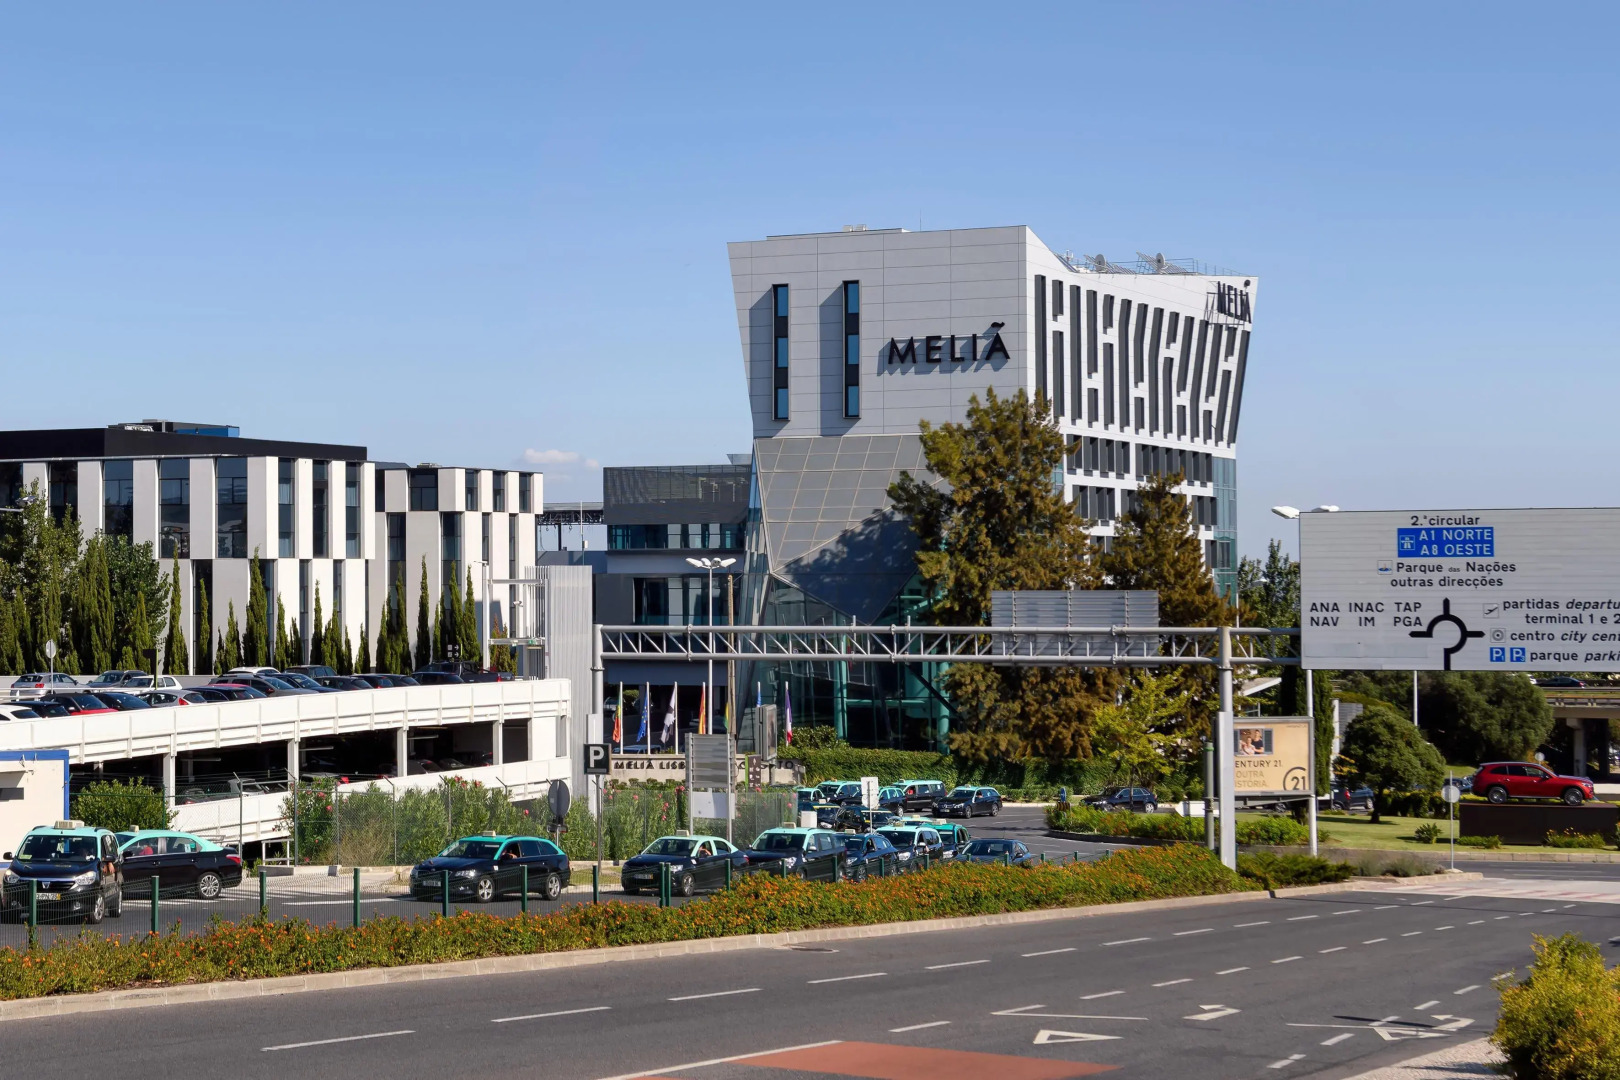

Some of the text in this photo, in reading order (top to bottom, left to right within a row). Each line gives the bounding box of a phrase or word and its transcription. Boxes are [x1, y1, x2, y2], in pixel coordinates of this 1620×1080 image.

[888, 321, 1011, 365] MELIÁ
[1428, 514, 1480, 526] circular
[1419, 528, 1492, 541] A1 NORTE
[1420, 543, 1492, 556] A8 OESTE
[1396, 562, 1444, 574] Parque
[1466, 561, 1517, 575] Nações
[1390, 575, 1504, 589] outras direcções
[1309, 601, 1422, 613] ANA INAC TAP
[1503, 599, 1560, 611] partidas
[1310, 616, 1423, 627] NAV IM PGA
[1525, 613, 1620, 625] terminal 1 e 2
[1510, 630, 1555, 641] centro
[1561, 630, 1588, 643] city
[1530, 651, 1578, 662] parque
[589, 746, 605, 768] P
[614, 759, 686, 770] MELIÁ LISB
[1235, 760, 1271, 768] ENTURY
[1235, 770, 1265, 779] OUTRA
